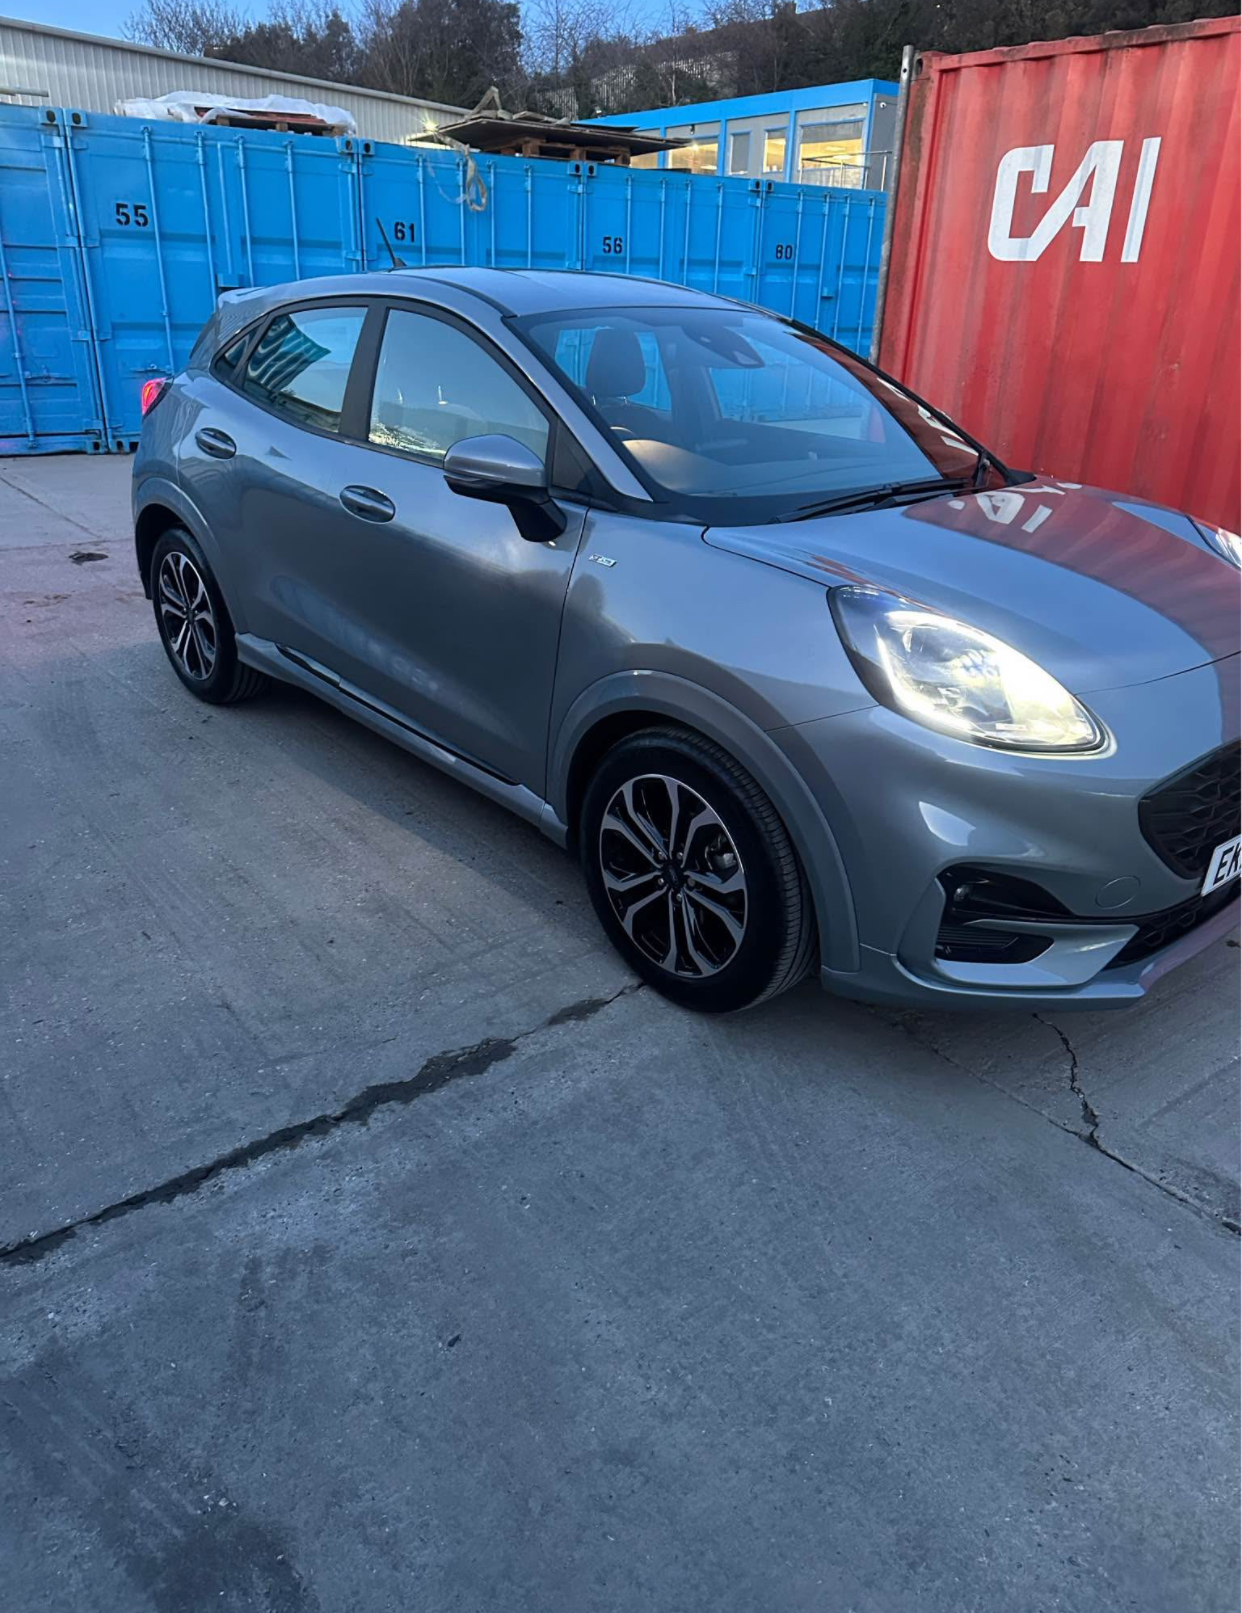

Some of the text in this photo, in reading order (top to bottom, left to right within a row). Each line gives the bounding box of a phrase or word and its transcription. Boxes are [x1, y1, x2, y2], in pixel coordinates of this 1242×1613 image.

[987, 136, 1162, 263] CAI
[115, 202, 149, 227] 55
[394, 221, 415, 243] 61
[602, 236, 623, 254] 56
[1213, 841, 1241, 886] EK
